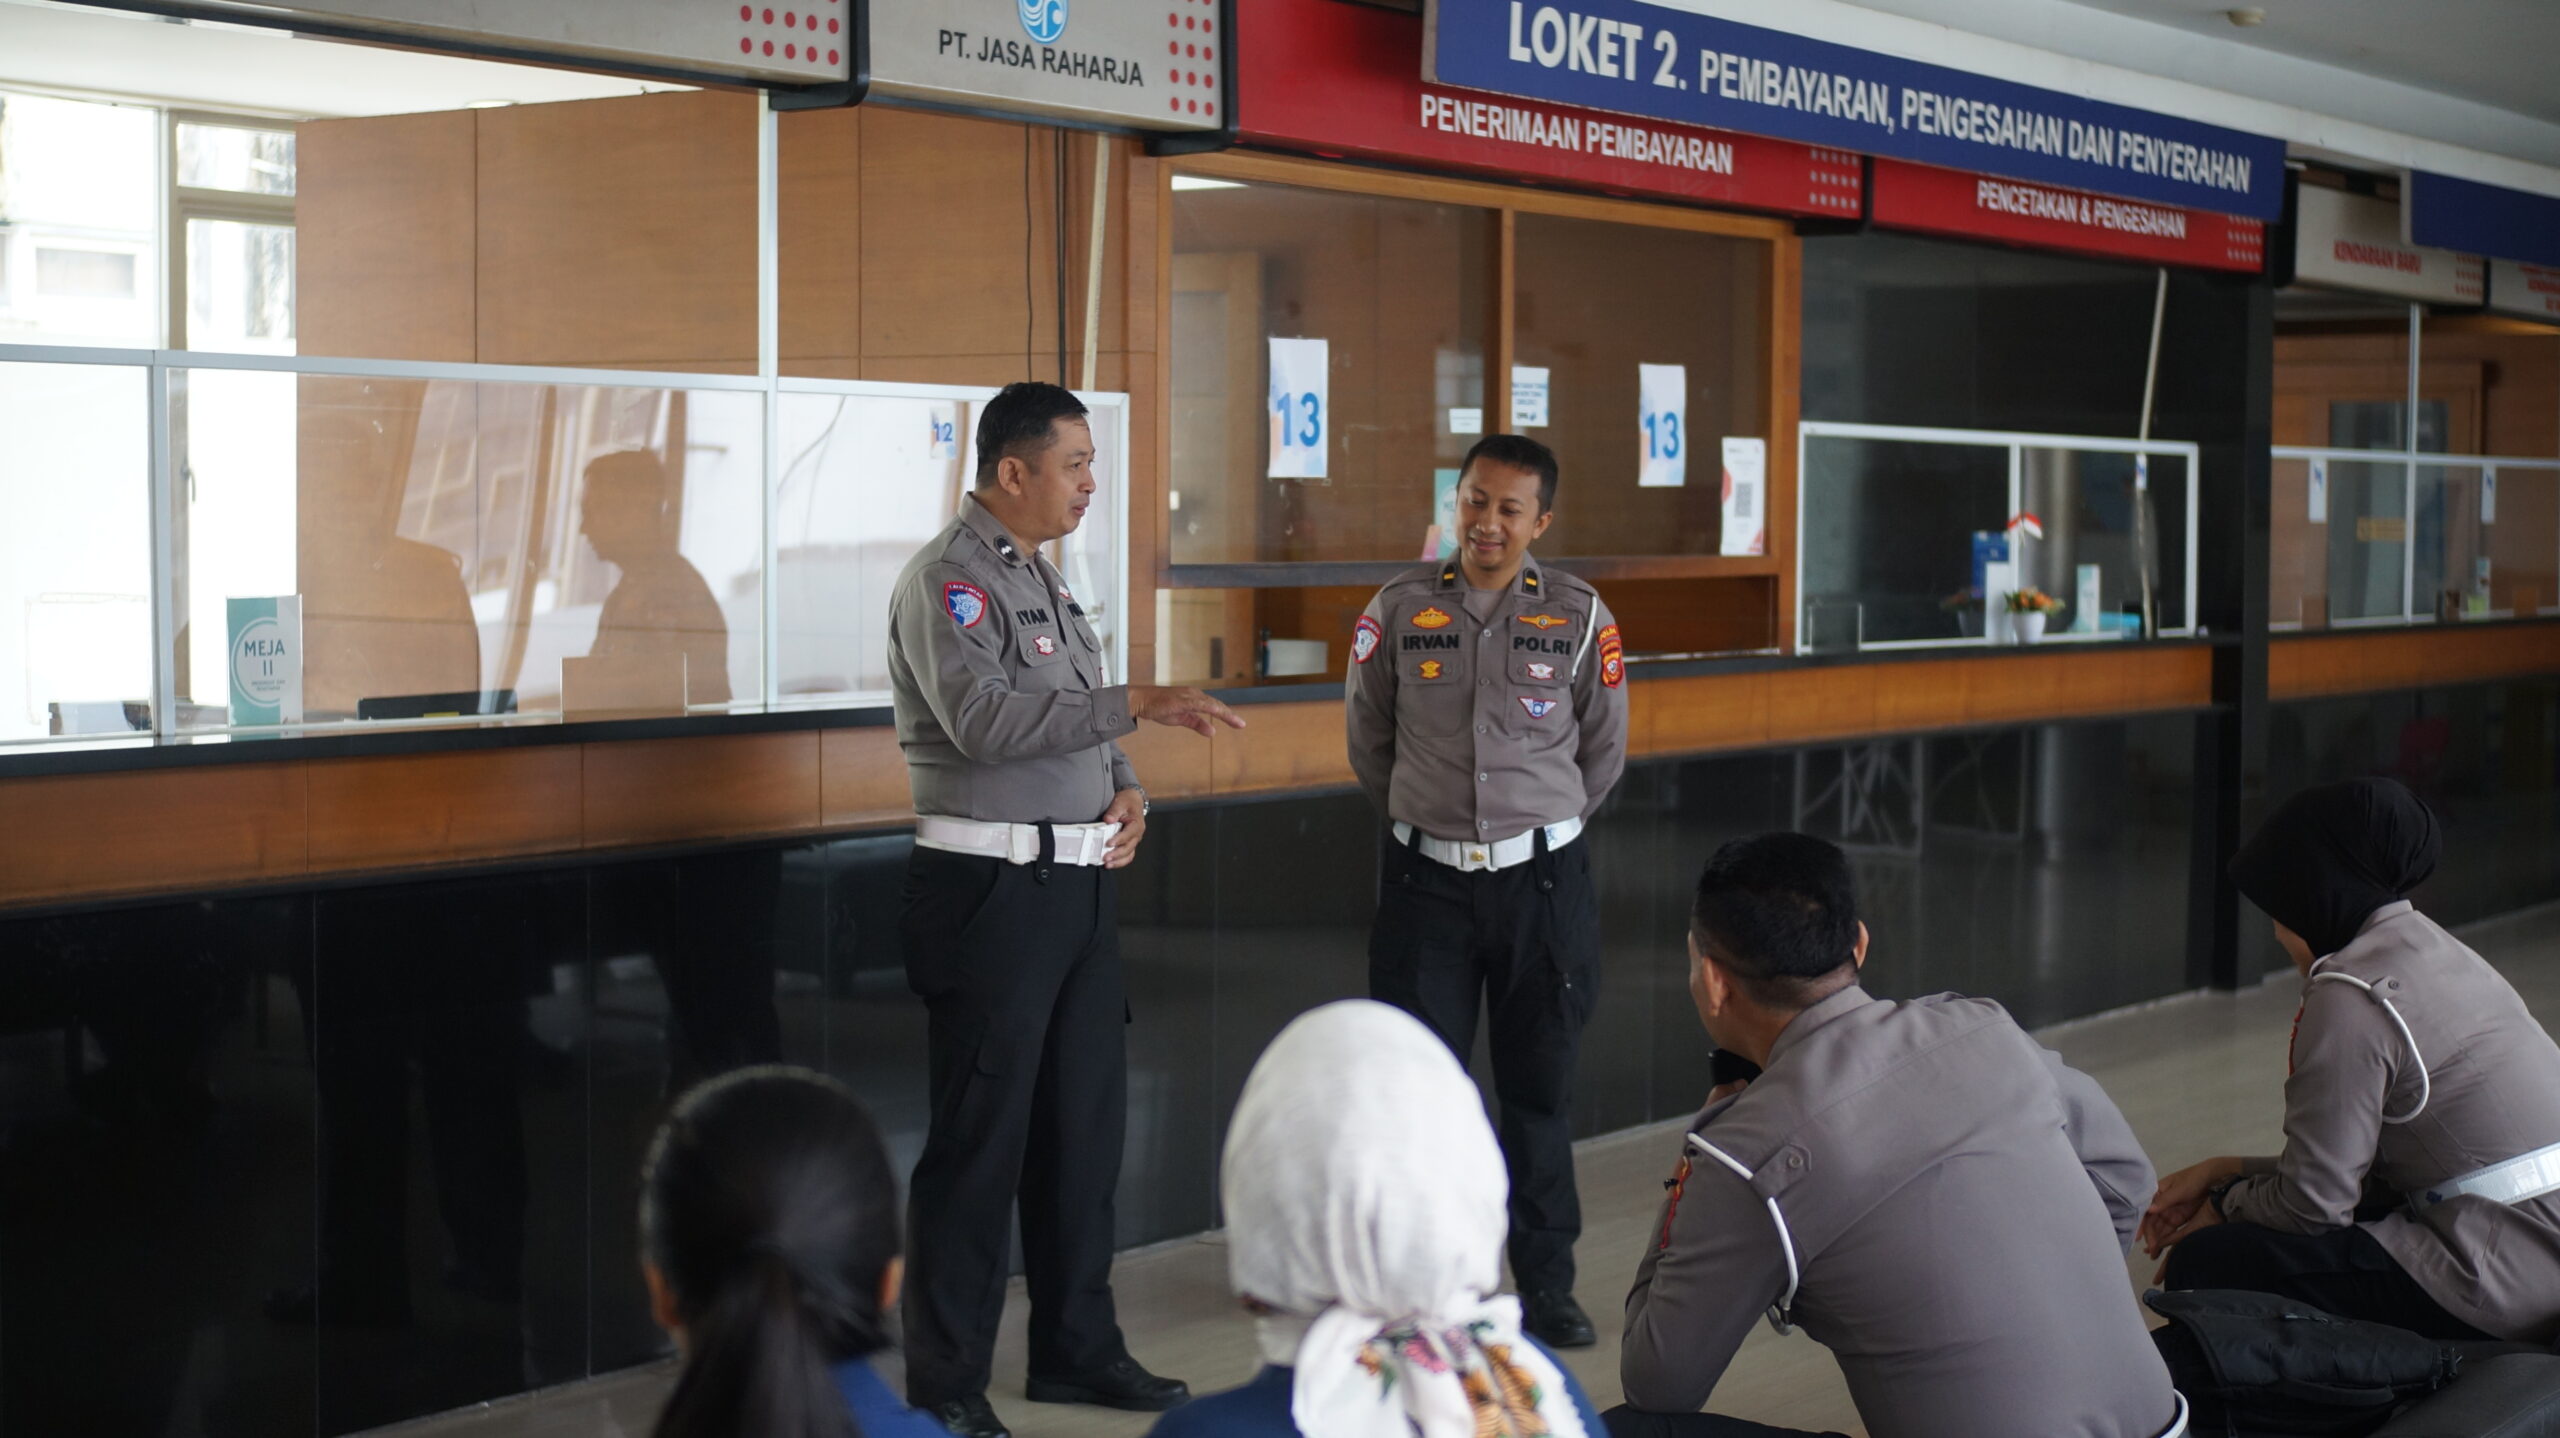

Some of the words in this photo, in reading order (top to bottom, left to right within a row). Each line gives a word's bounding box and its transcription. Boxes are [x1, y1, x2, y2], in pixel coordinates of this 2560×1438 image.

[938, 29, 971, 59] PT.
[977, 36, 1036, 70] JASA
[1042, 47, 1145, 87] RAHARJA
[1508, 1, 1643, 82] LOKET
[1652, 30, 1687, 90] 2.
[1700, 49, 1895, 136] PEMBAYARAN,
[1901, 86, 2064, 158] PENGESAHAN
[2067, 120, 2115, 168] DAN
[2118, 127, 2251, 194] PENYERAHAN
[1420, 94, 1580, 153] PENERIMAAN
[1585, 119, 1734, 176] PEMBAYARAN
[1976, 179, 2079, 224] PENCETAKAN
[2079, 199, 2092, 225] &
[2093, 198, 2186, 240] PENGESAHAN
[933, 422, 953, 442] 12
[1276, 391, 1321, 448] 13
[1645, 411, 1680, 460] 13
[1016, 608, 1050, 626] IYAN
[244, 639, 286, 657] MEJA
[1403, 634, 1460, 651] IRVAN
[1513, 636, 1572, 656] POLRI
